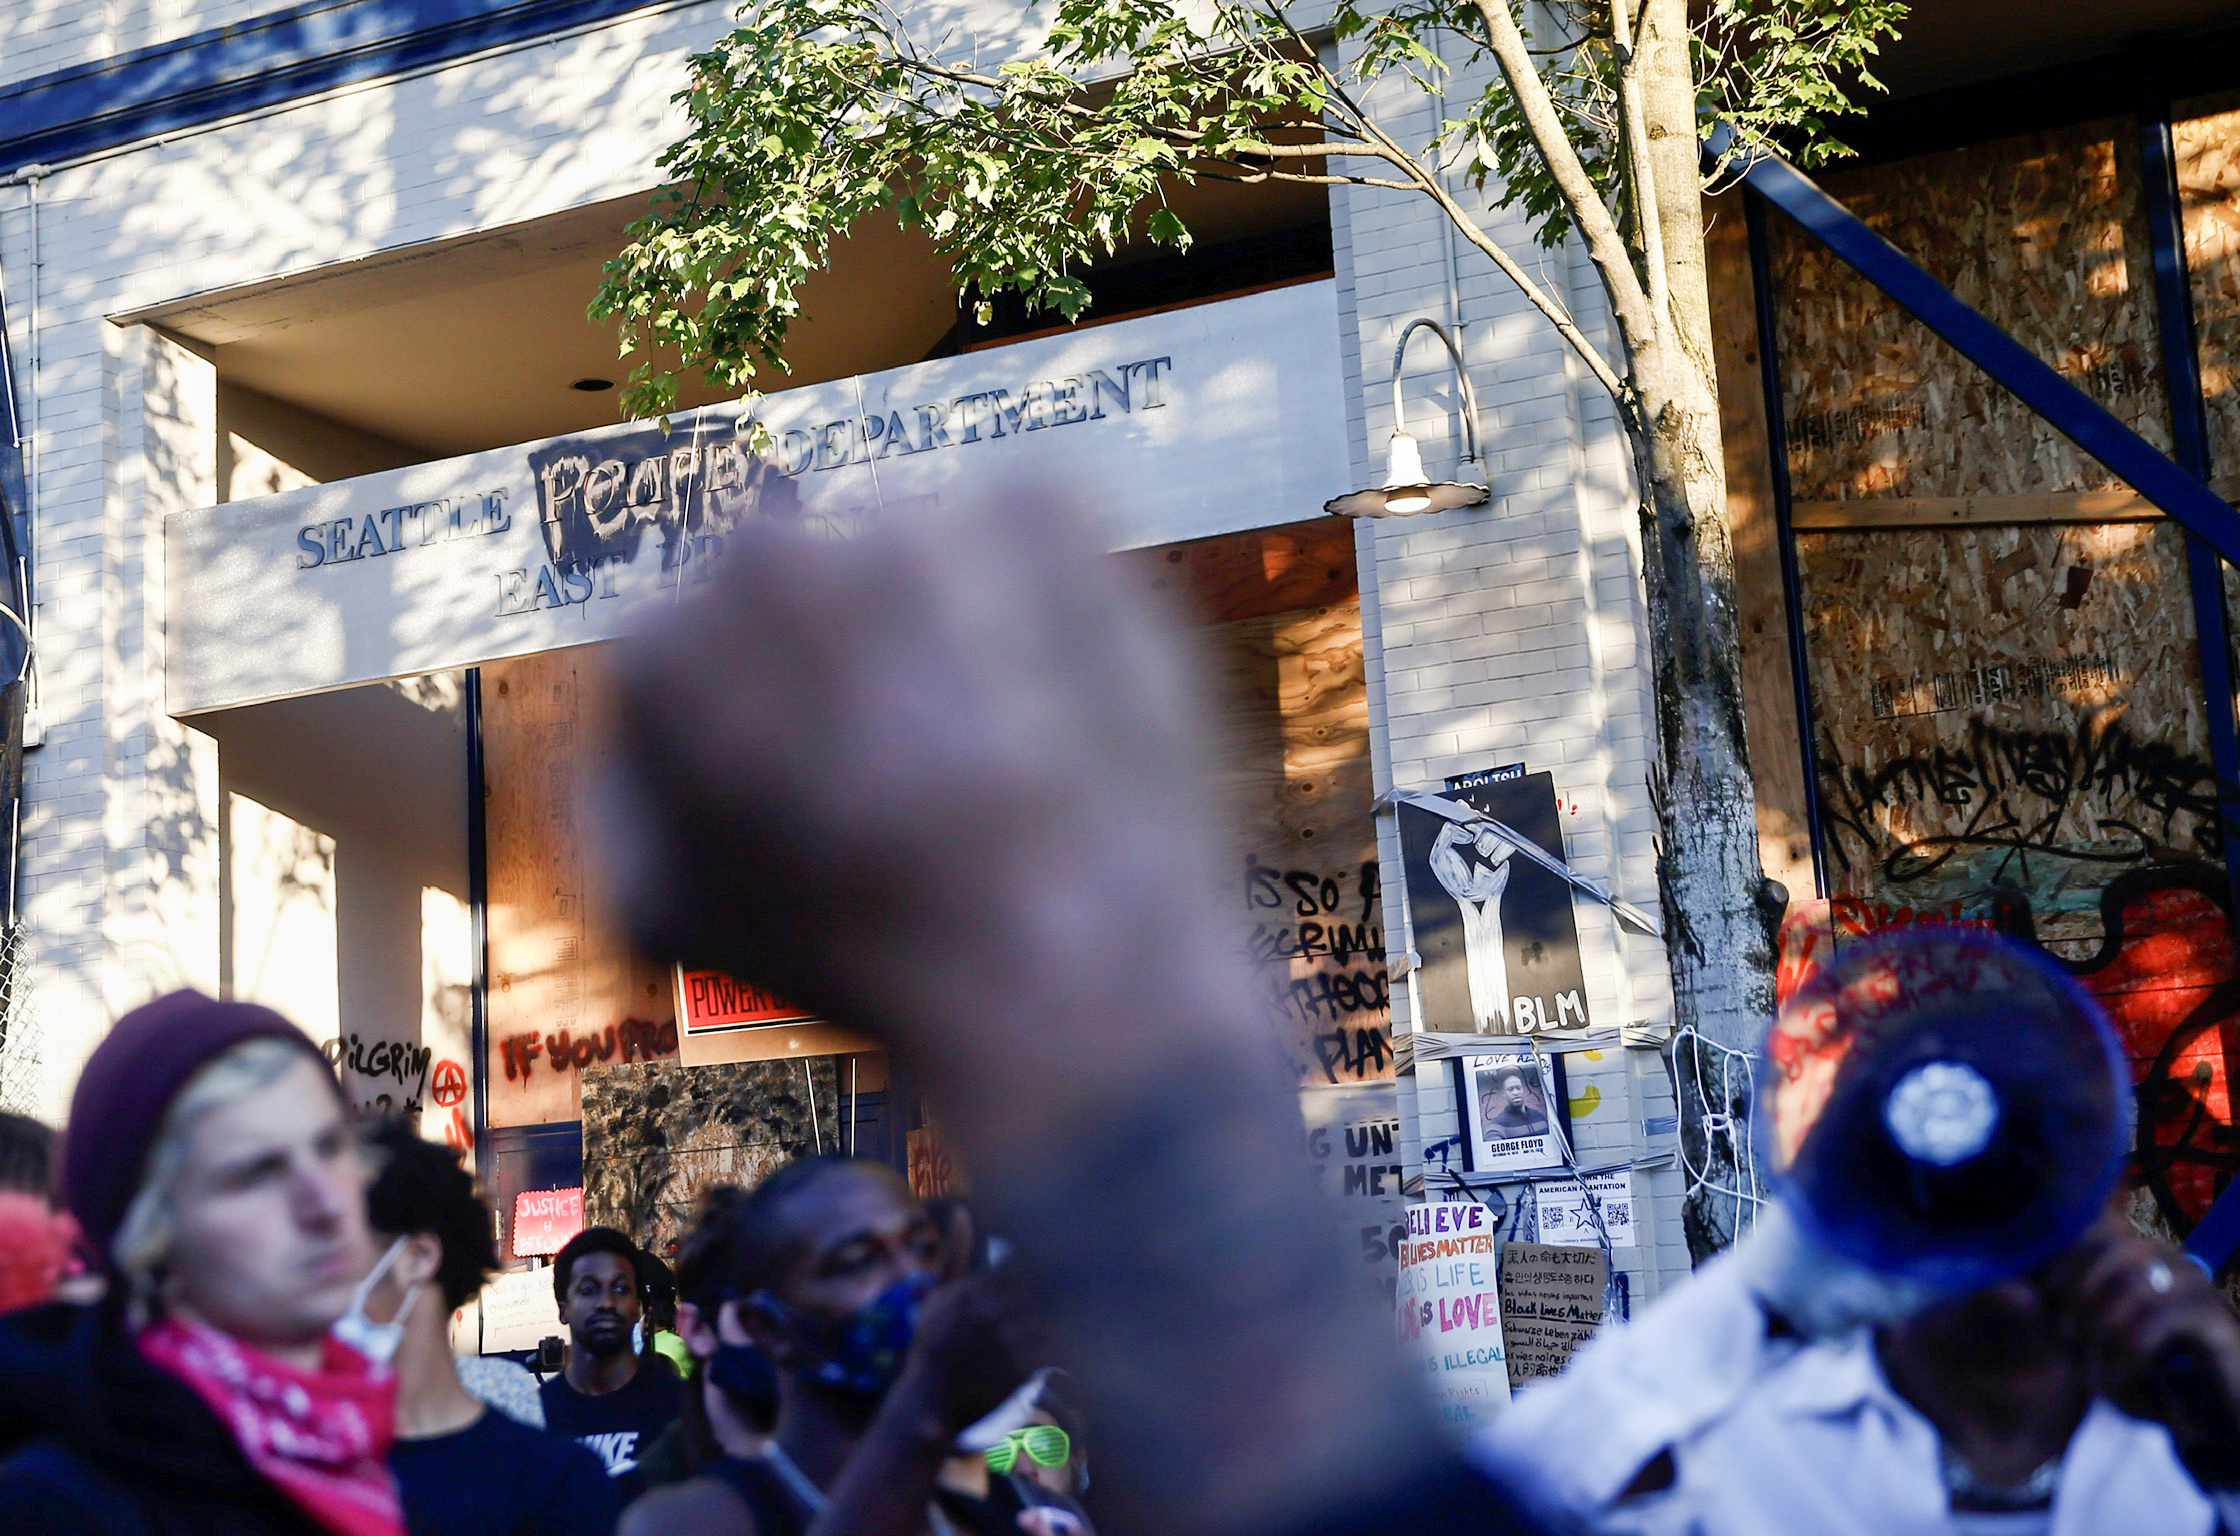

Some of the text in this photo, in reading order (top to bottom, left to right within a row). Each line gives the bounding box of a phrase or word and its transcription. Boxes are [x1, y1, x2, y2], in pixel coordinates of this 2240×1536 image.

[772, 355, 1172, 478] DEPARTMENT
[297, 486, 511, 569] SEATTLE
[493, 550, 627, 617] EAST
[1285, 868, 1339, 916] SO
[1513, 990, 1586, 1034] BLM
[501, 1031, 544, 1081] IF
[547, 1026, 616, 1072] YOU
[1473, 1053, 1510, 1067] LOVE
[1491, 1142, 1519, 1153] GEORGE
[1521, 1138, 1544, 1150] FLOYD
[1539, 1182, 1626, 1194] AMERICAN PANTATION
[519, 1196, 579, 1220] JUSTICE
[1436, 1234, 1493, 1258] MATTER
[1435, 1263, 1484, 1287] LIFE
[1419, 1300, 1434, 1328] IS
[1438, 1292, 1498, 1333] LOVE
[1504, 1299, 1604, 1321] Black Lives Matter
[1504, 1321, 1543, 1335] Schwarze
[1544, 1327, 1570, 1339] Leben
[1443, 1346, 1505, 1371] ILLEGAL
[1515, 1351, 1533, 1361] vies
[1534, 1352, 1566, 1365] noires
